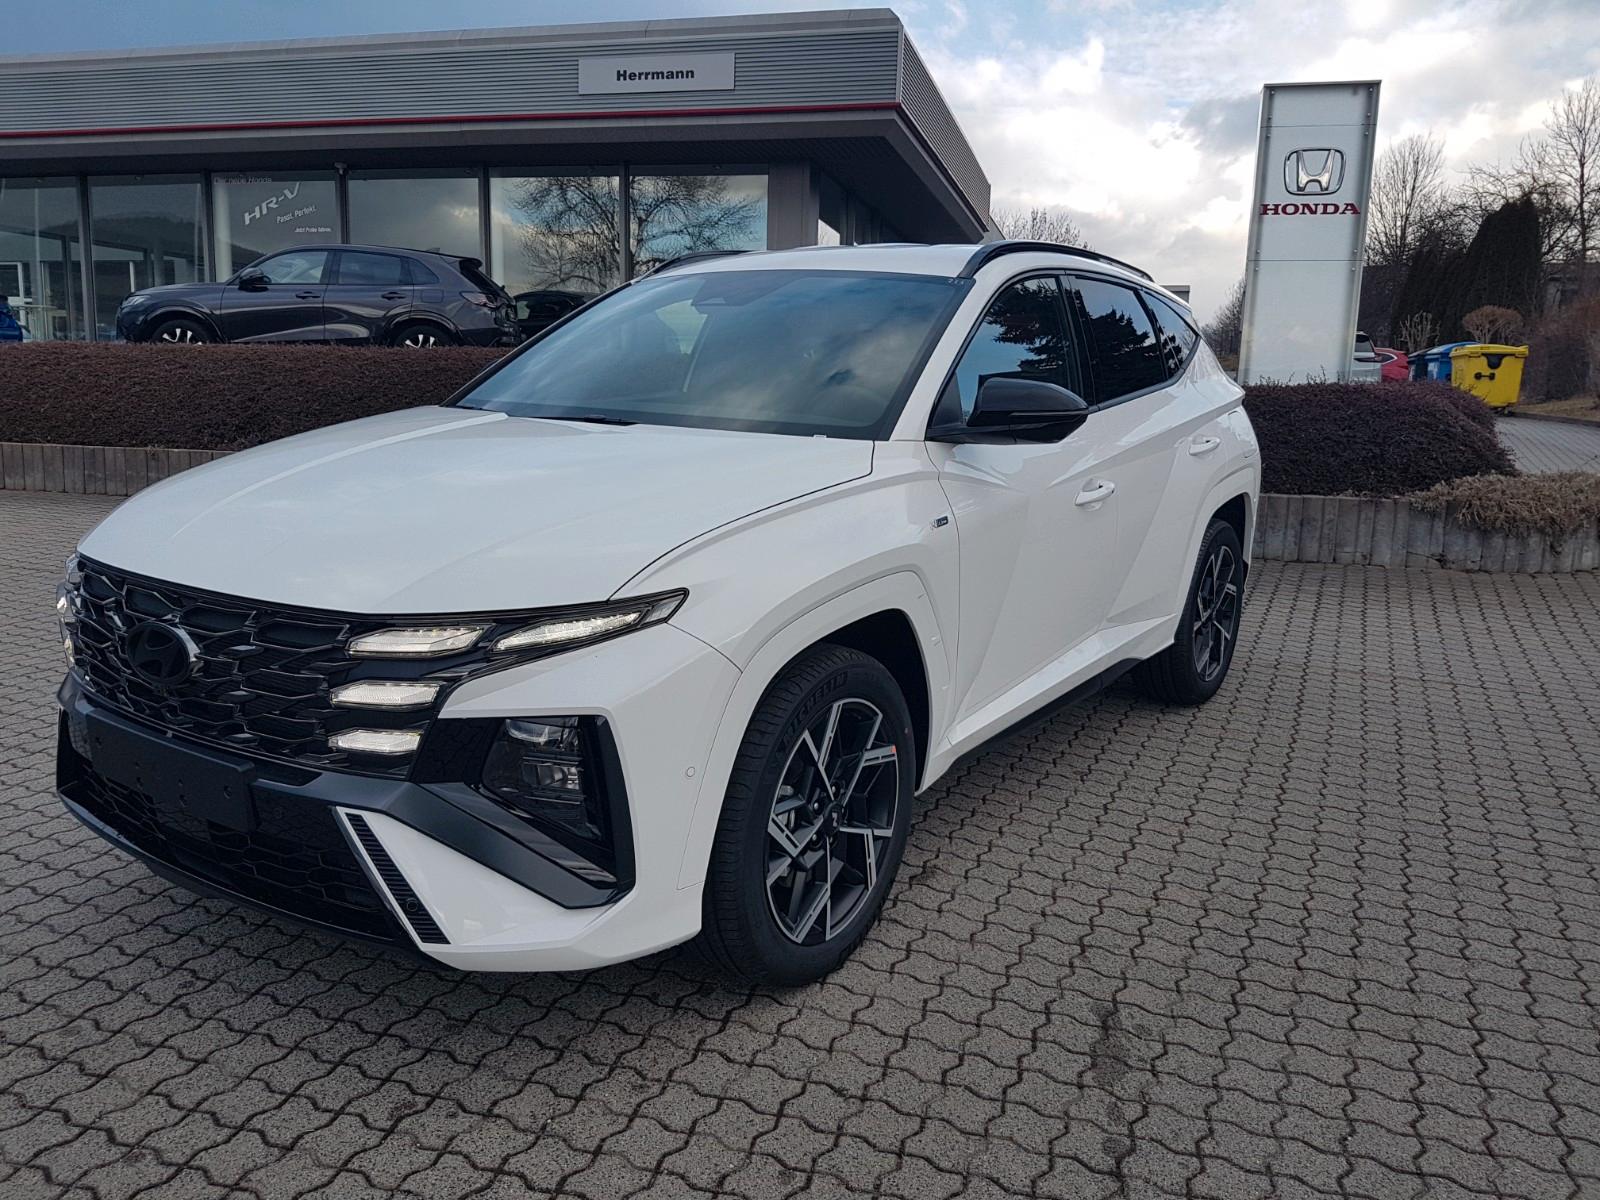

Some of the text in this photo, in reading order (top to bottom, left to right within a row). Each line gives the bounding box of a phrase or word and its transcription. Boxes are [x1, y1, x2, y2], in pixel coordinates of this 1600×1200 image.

[616, 69, 695, 81] Herrmann
[244, 182, 300, 225] HR-V
[1260, 203, 1361, 215] HONDA
